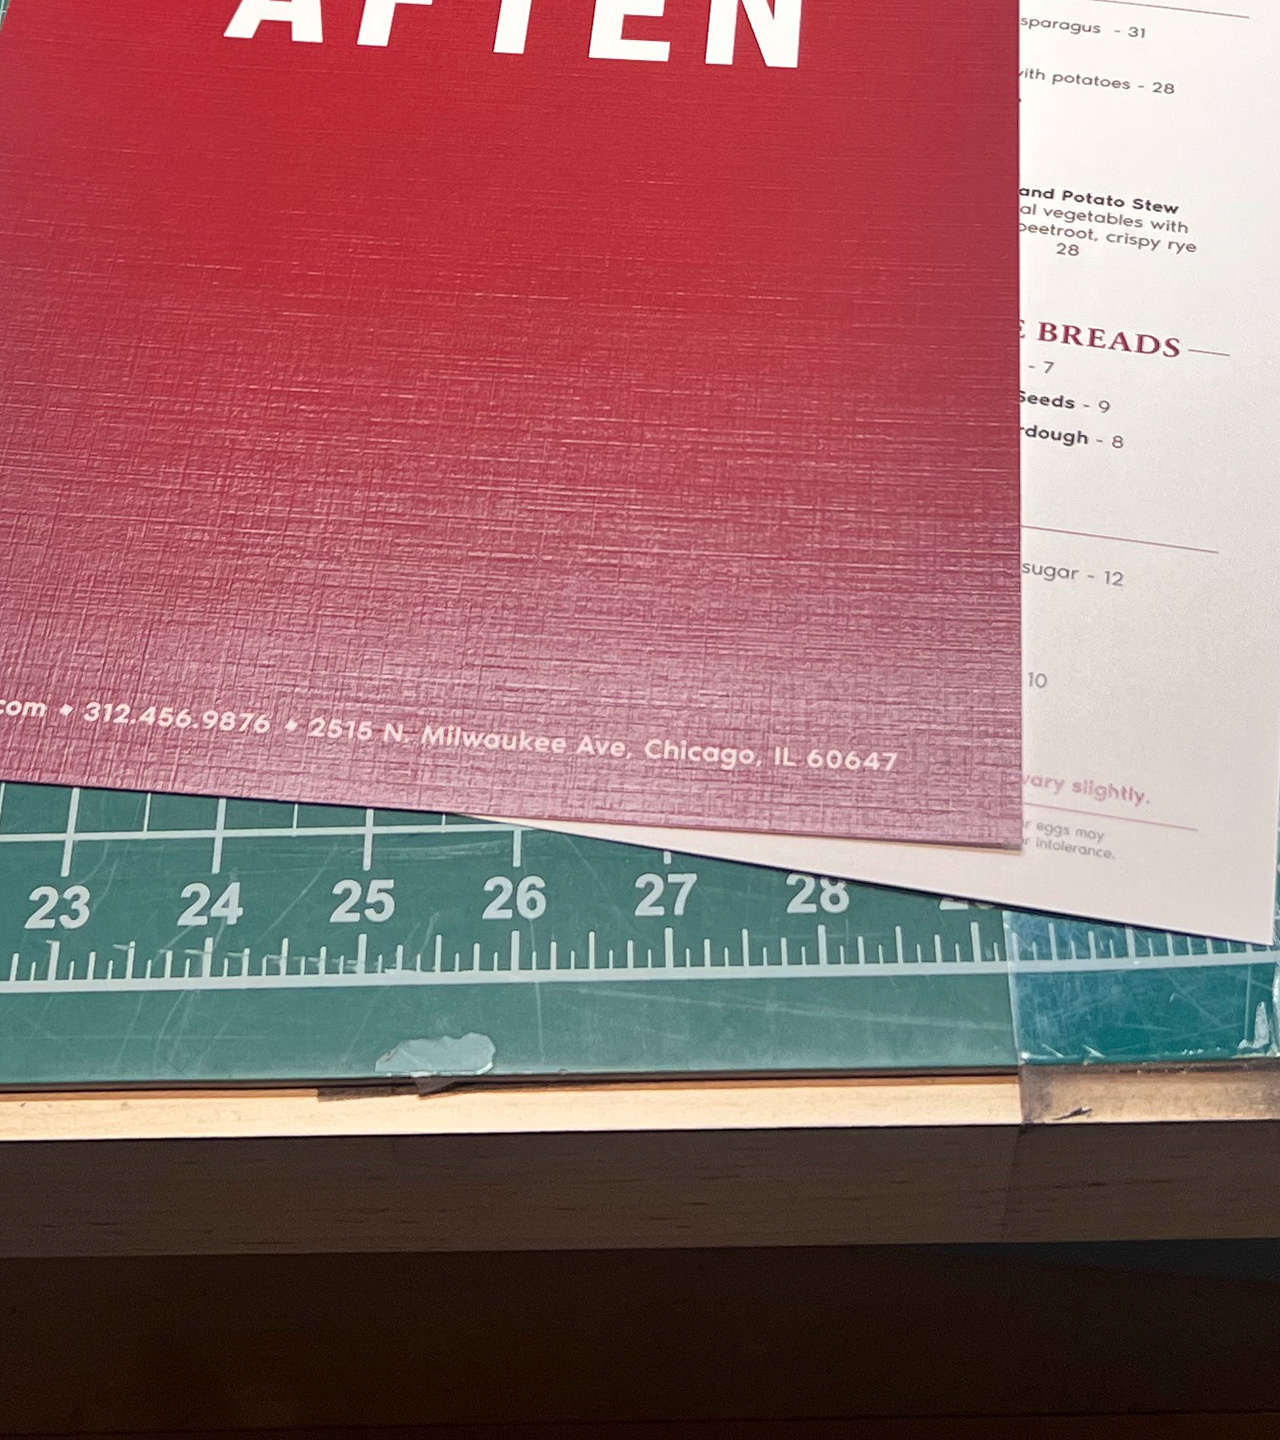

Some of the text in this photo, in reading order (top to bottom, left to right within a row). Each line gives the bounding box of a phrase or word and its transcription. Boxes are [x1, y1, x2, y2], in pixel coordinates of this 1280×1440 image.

[1052, 74, 1175, 94] potatoes 28
[1062, 190, 1179, 214] Potato Stew
[1043, 208, 1188, 233] vegetables with
[1056, 243, 1079, 256] 28
[1106, 232, 1197, 254] crispy rye
[1037, 322, 1180, 357] BREADS
[1098, 400, 1111, 413] 9
[1112, 435, 1124, 449] 8
[1023, 563, 1124, 587] sugar 12
[1028, 672, 1048, 689] 10
[84, 702, 270, 733] 312.456.9876
[309, 717, 372, 740] 2515
[383, 723, 409, 743] N.
[421, 725, 566, 753] Milwaukee
[577, 735, 632, 759] Ave,
[645, 739, 762, 770] Chicago,
[775, 747, 796, 766] IL
[807, 749, 897, 770] 60647
[177, 882, 243, 926] 24
[330, 879, 394, 923] 25
[482, 876, 546, 920] 26
[635, 873, 697, 916] 27
[786, 872, 850, 914] 28
[24, 885, 90, 929] 23
